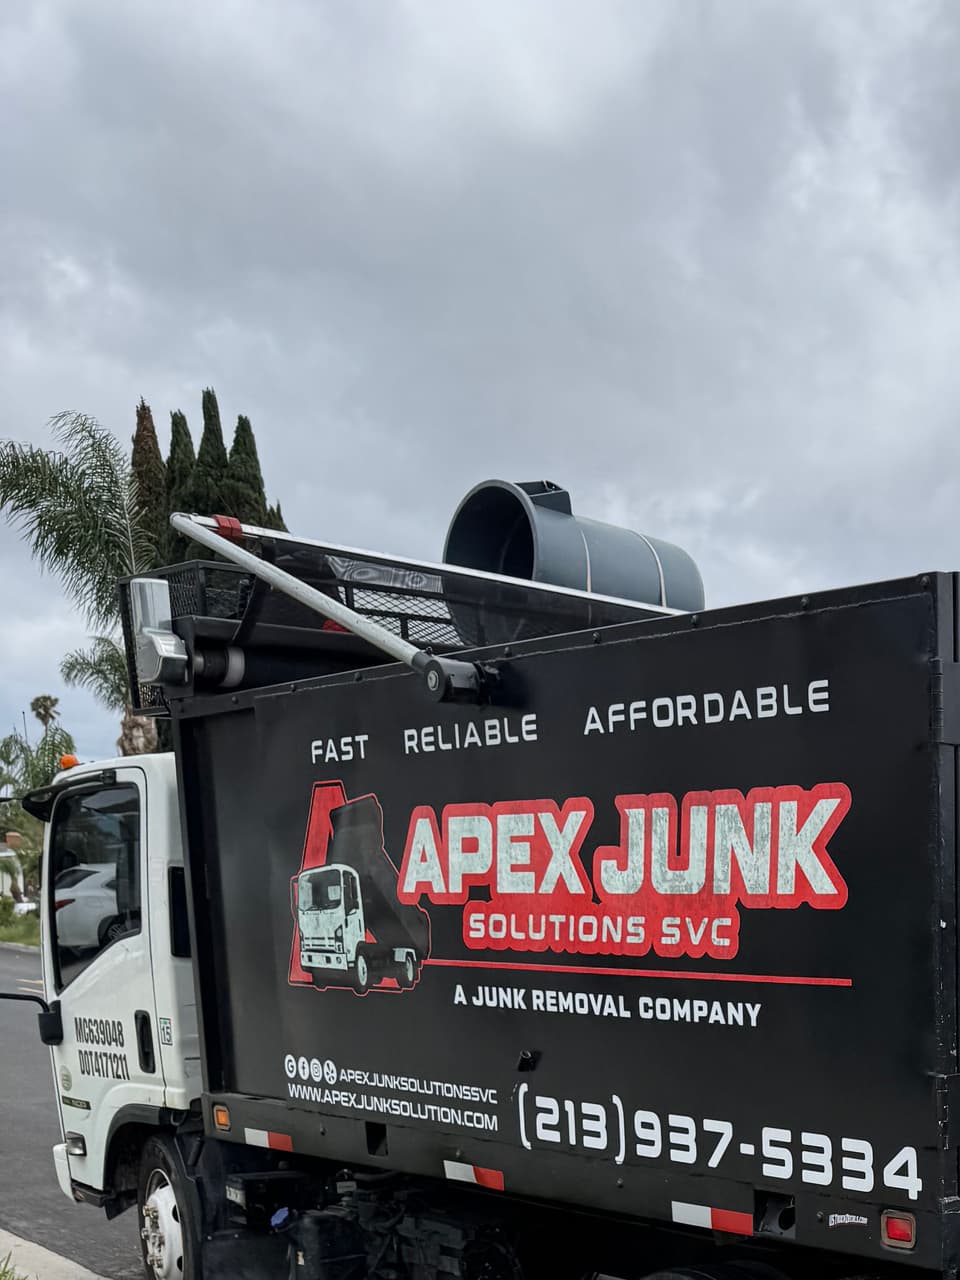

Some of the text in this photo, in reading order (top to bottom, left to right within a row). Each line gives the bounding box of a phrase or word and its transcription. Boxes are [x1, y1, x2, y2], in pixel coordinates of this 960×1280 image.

[311, 679, 829, 764] FAST RELIABLE AFFORDABLE
[402, 798, 842, 895] APEX JUNK
[469, 912, 732, 947] SOLUTIONS SVC
[454, 984, 761, 1028] A JUNK REMOVAL COMPANY
[74, 1017, 125, 1048] MC639048
[78, 1049, 131, 1080] DOT4171211
[339, 1068, 498, 1104] APEXJUNKSOLUTIONSSVC
[288, 1083, 498, 1131] WWW.APEXJUNKSOLUTION.COM
[518, 1083, 923, 1201] (213)937-5334
